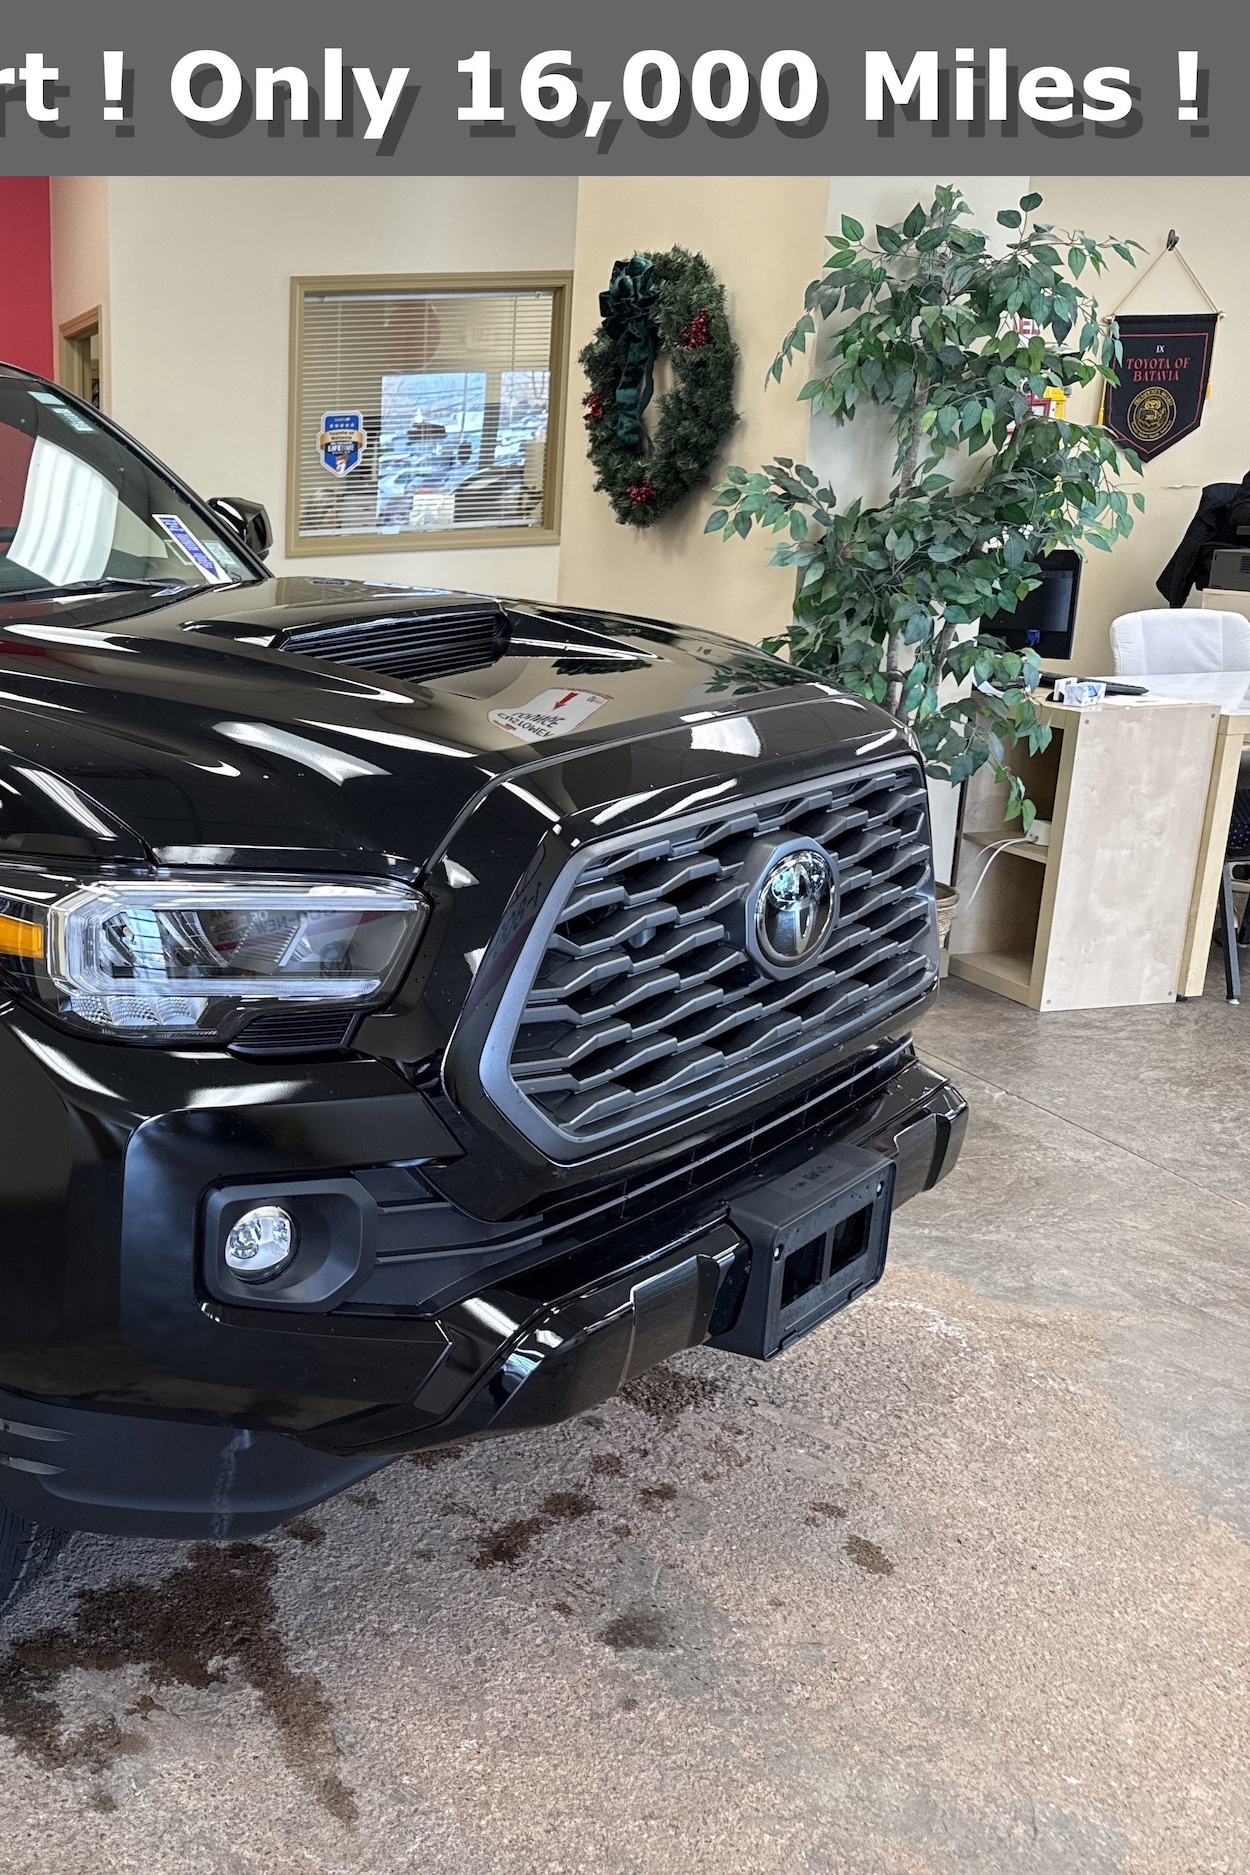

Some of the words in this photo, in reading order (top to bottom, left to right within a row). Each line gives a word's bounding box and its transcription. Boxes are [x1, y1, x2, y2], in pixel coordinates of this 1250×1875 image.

[1127, 358, 1171, 370] TOYOTA
[1174, 357, 1190, 369] OF
[1133, 370, 1180, 382] BATAVIA
